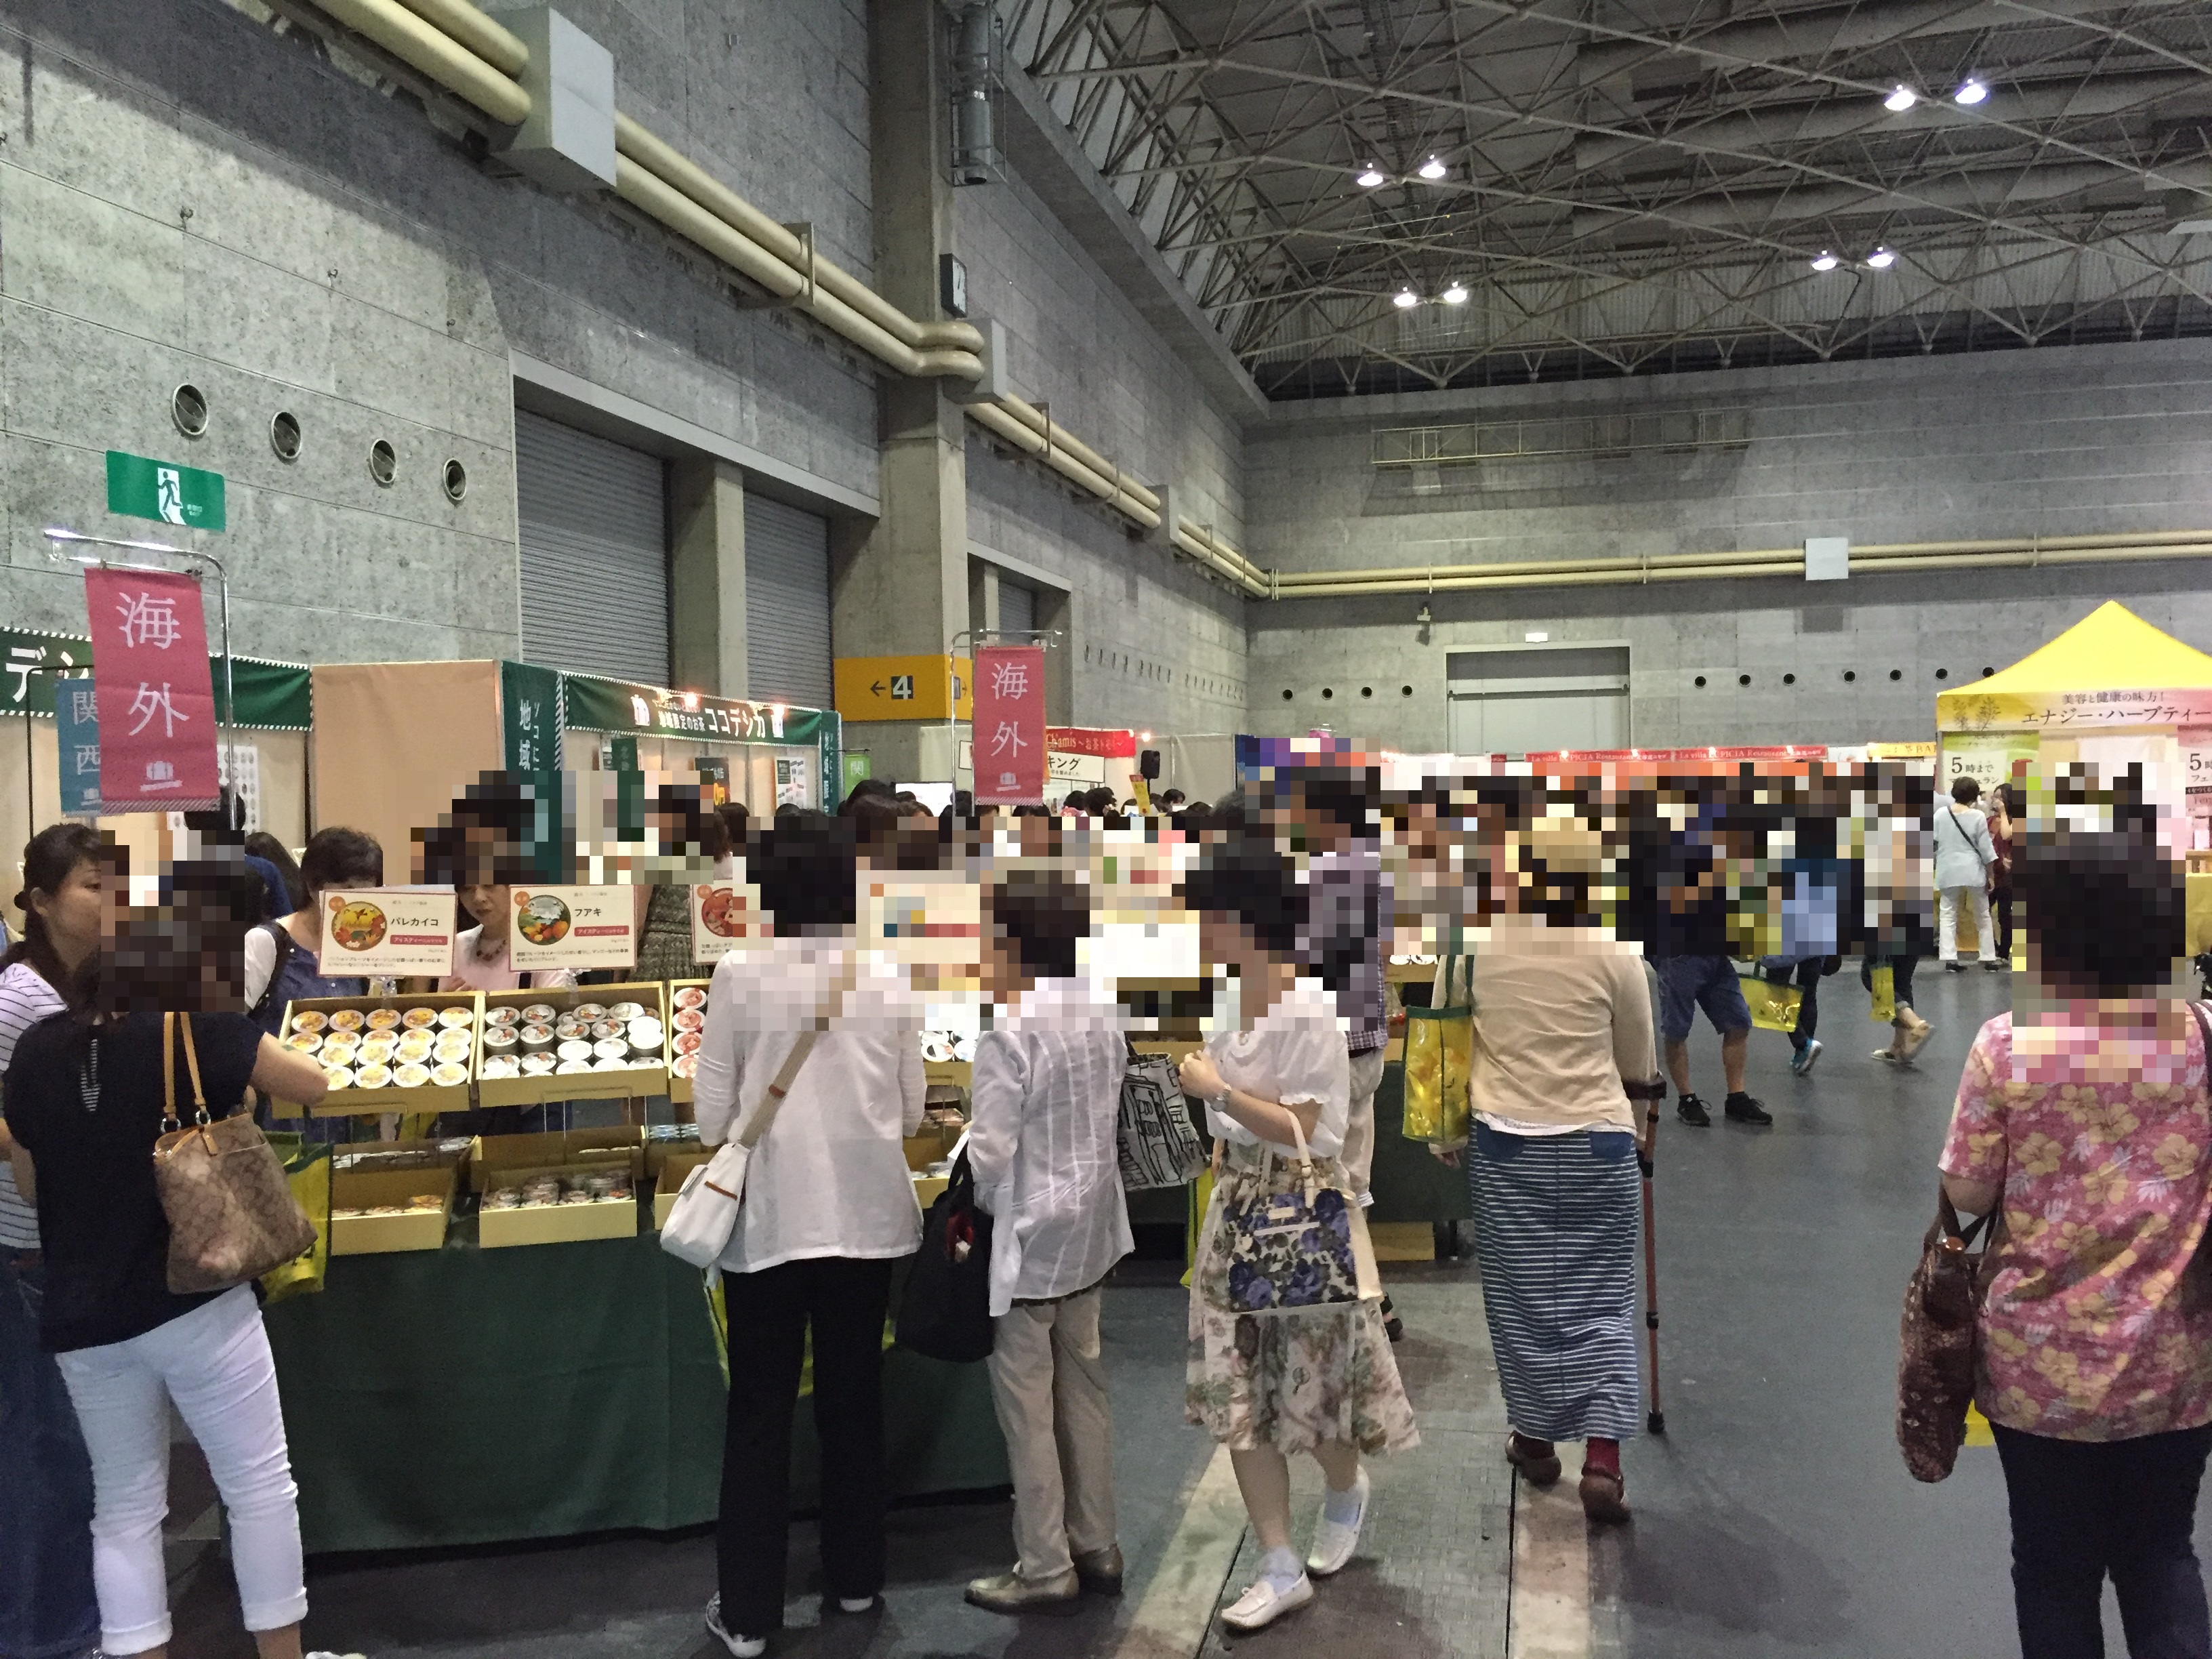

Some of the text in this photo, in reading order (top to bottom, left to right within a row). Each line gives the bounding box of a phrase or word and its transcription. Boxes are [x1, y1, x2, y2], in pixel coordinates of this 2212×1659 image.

[116, 592, 190, 738] 海外
[893, 675, 912, 700] 4
[704, 708, 766, 739] ココデシカ
[990, 661, 1029, 758] 海外
[72, 691, 100, 776] 関西
[390, 917, 439, 927] バレカイコ
[574, 907, 602, 918] フアキ
